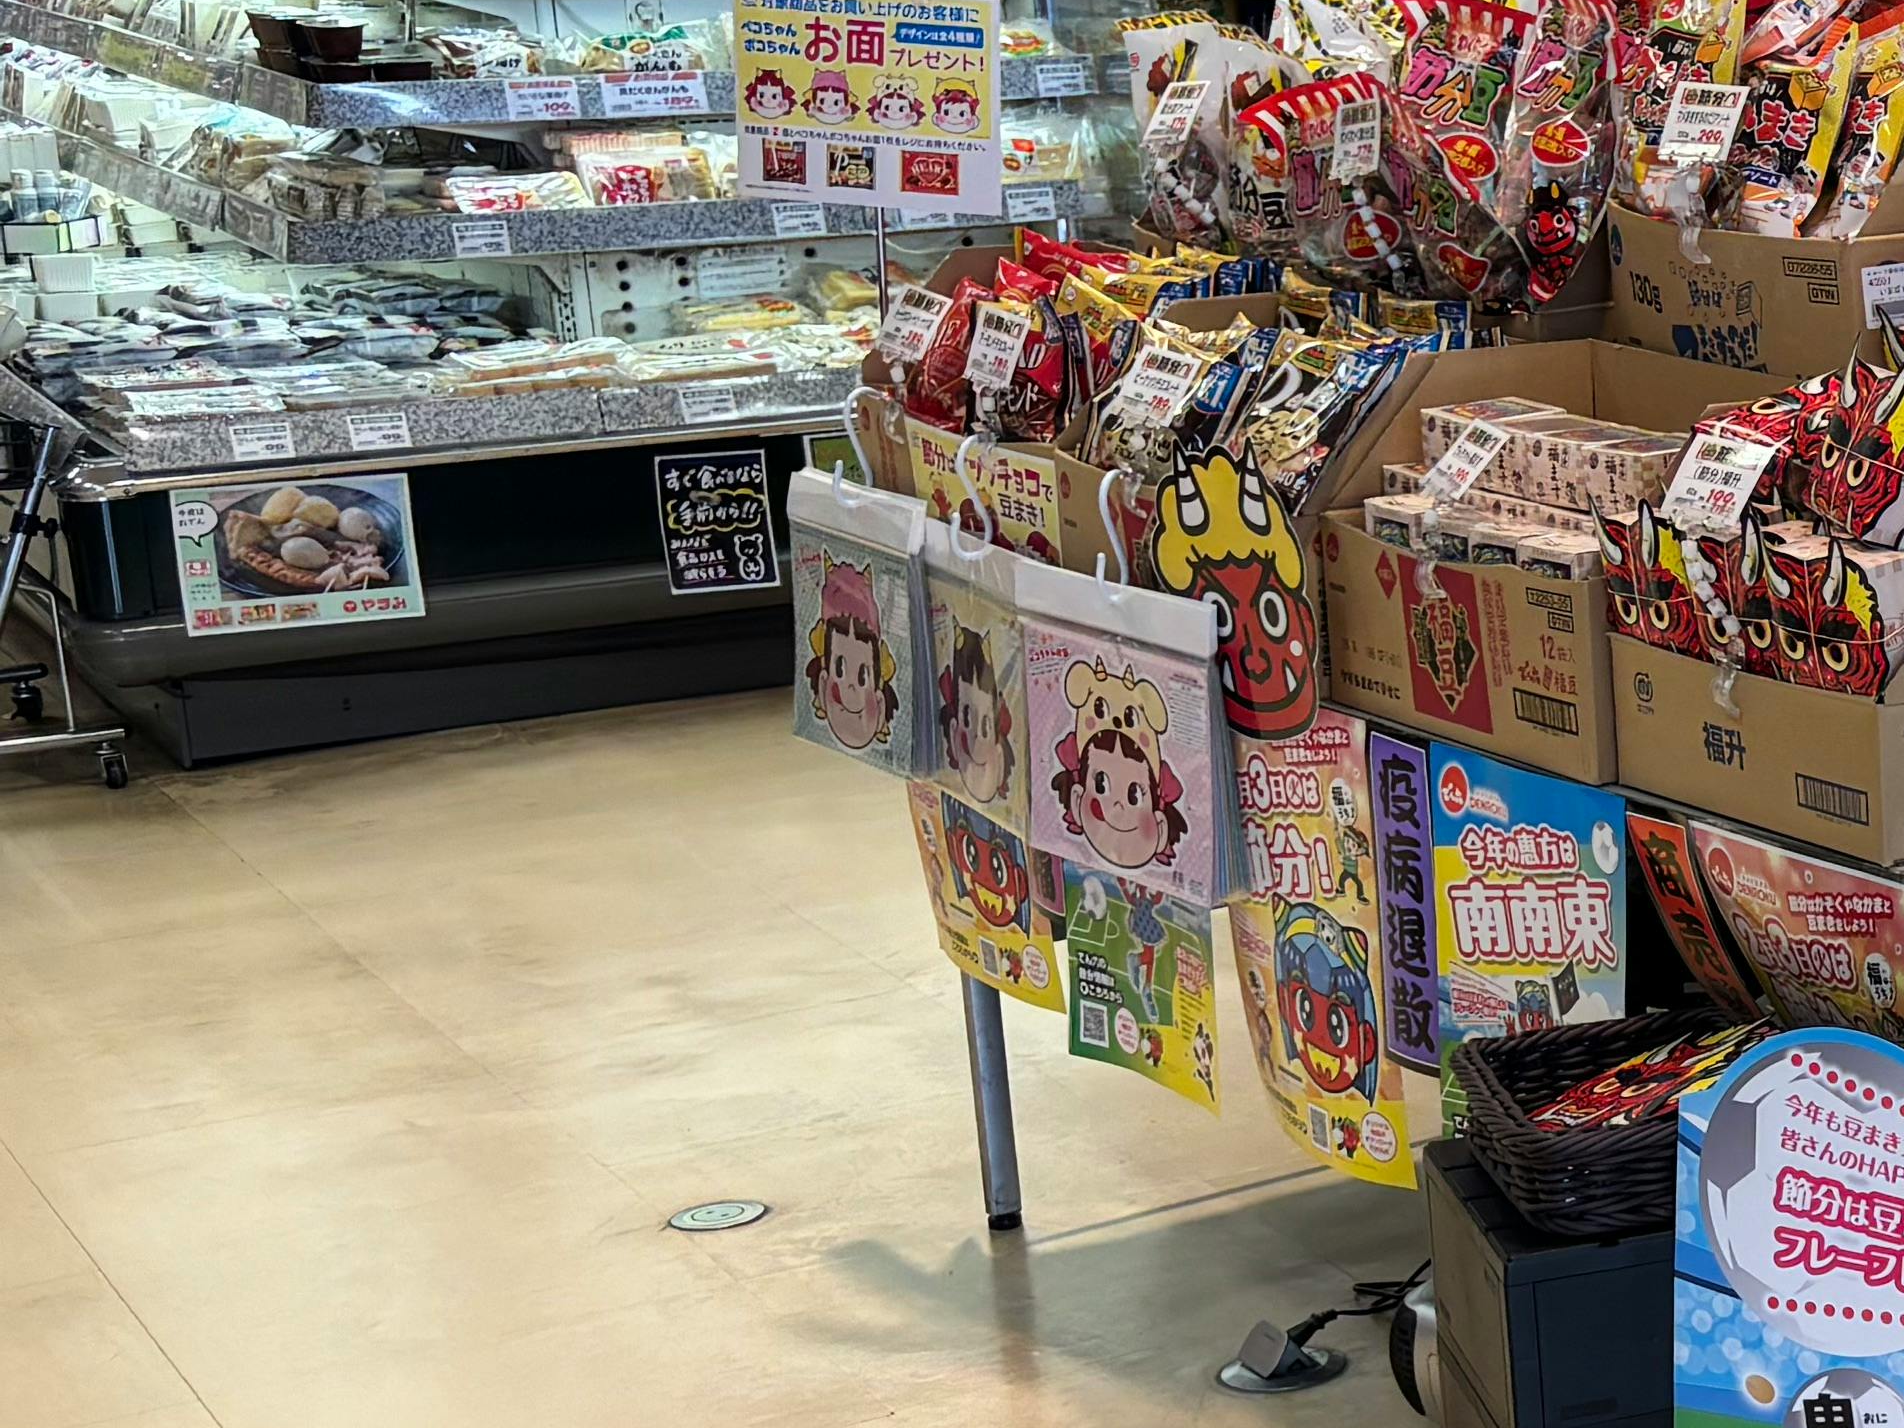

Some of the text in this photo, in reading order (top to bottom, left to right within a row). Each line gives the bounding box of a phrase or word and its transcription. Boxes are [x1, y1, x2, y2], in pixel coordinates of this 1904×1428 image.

[804, 16, 886, 68] お面
[888, 48, 986, 73] プレゼント!
[664, 463, 762, 491] すぐ食べるなら
[996, 493, 1047, 532] 豆まき!
[1701, 721, 1747, 771] 福升
[1460, 825, 1576, 870] 今年の恵方は
[1376, 752, 1436, 1057] 疫病退散
[1450, 877, 1616, 968] 南南東
